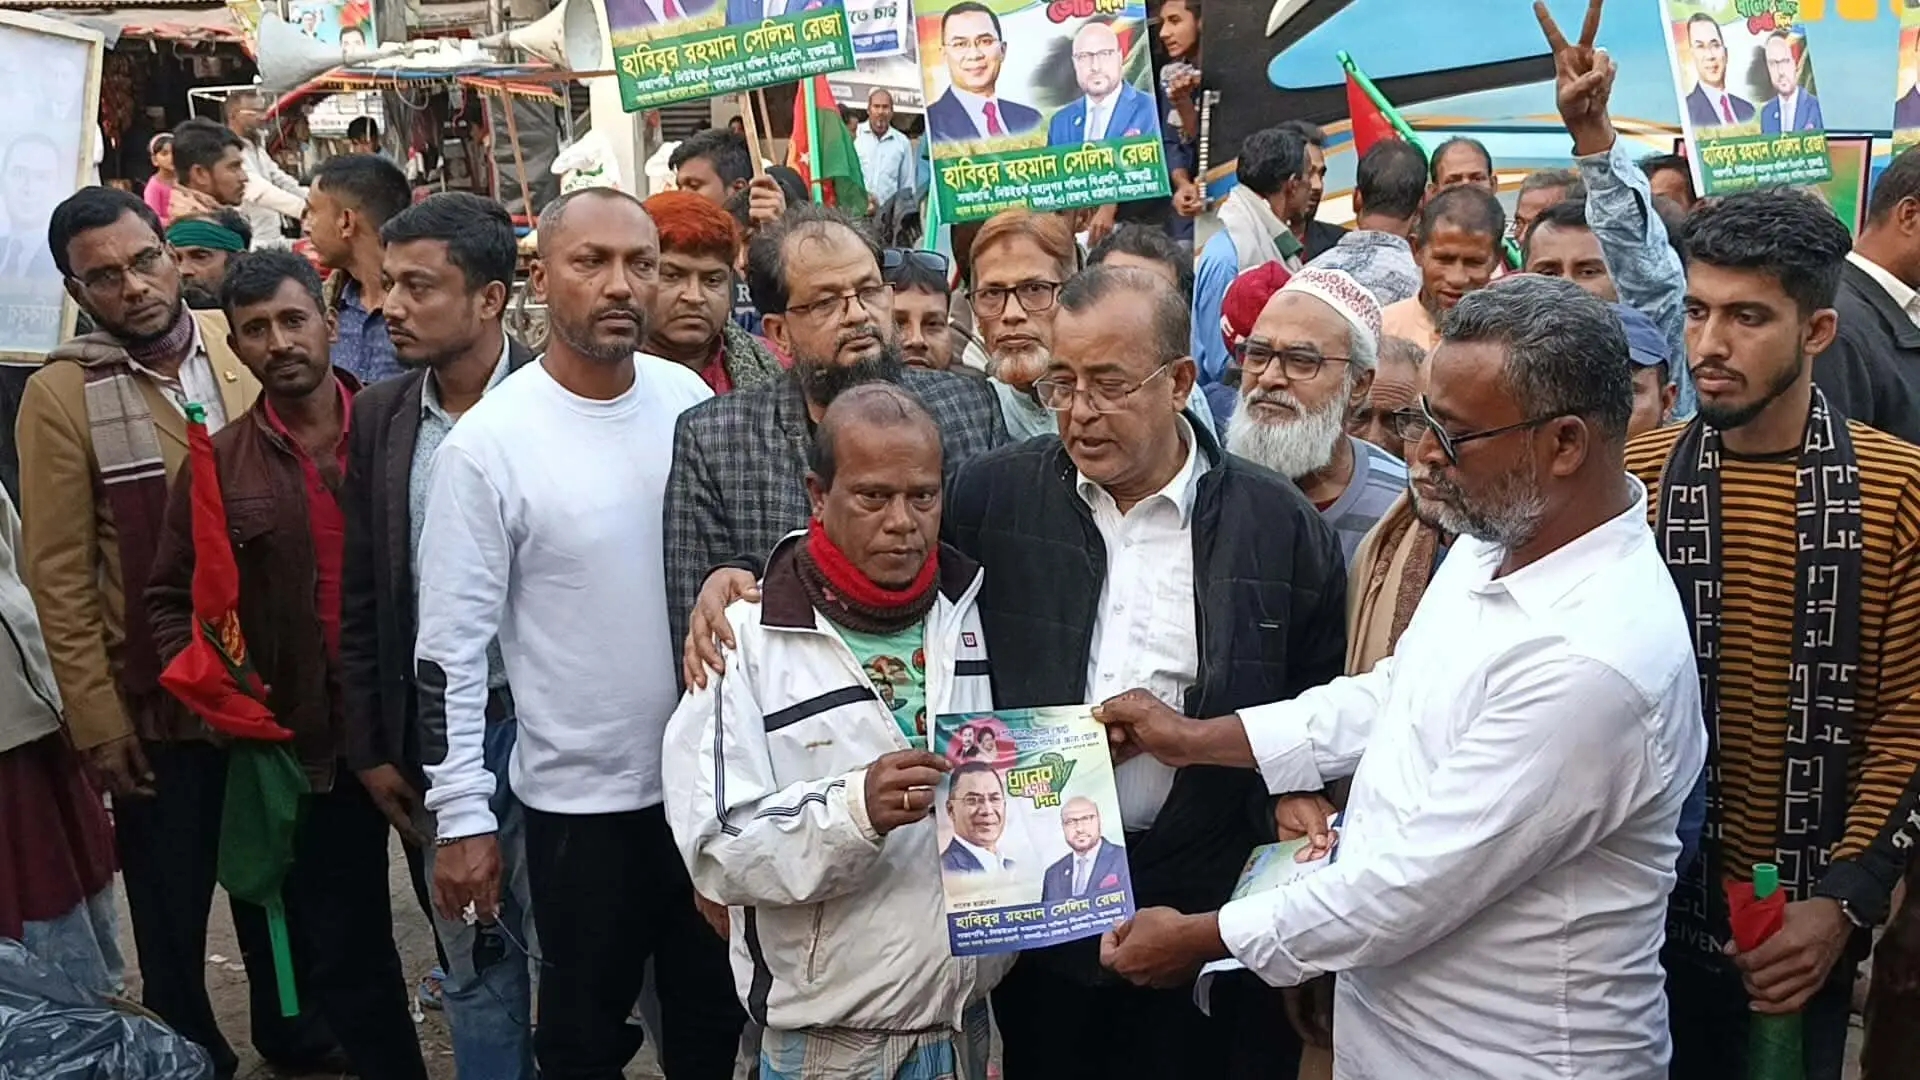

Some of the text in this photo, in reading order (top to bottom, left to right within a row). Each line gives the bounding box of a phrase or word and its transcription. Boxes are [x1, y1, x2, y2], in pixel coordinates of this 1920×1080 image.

[873, 2, 897, 20] চাই
[619, 10, 842, 79] হাবিবুর রহমান সেলিম রেজা
[941, 138, 1159, 191] হাবিবুর রহমান সেলিম রেজা
[1007, 766, 1053, 787] ধানের
[954, 890, 1126, 929] হাবিবুর রহমান সেলিম রেজা
